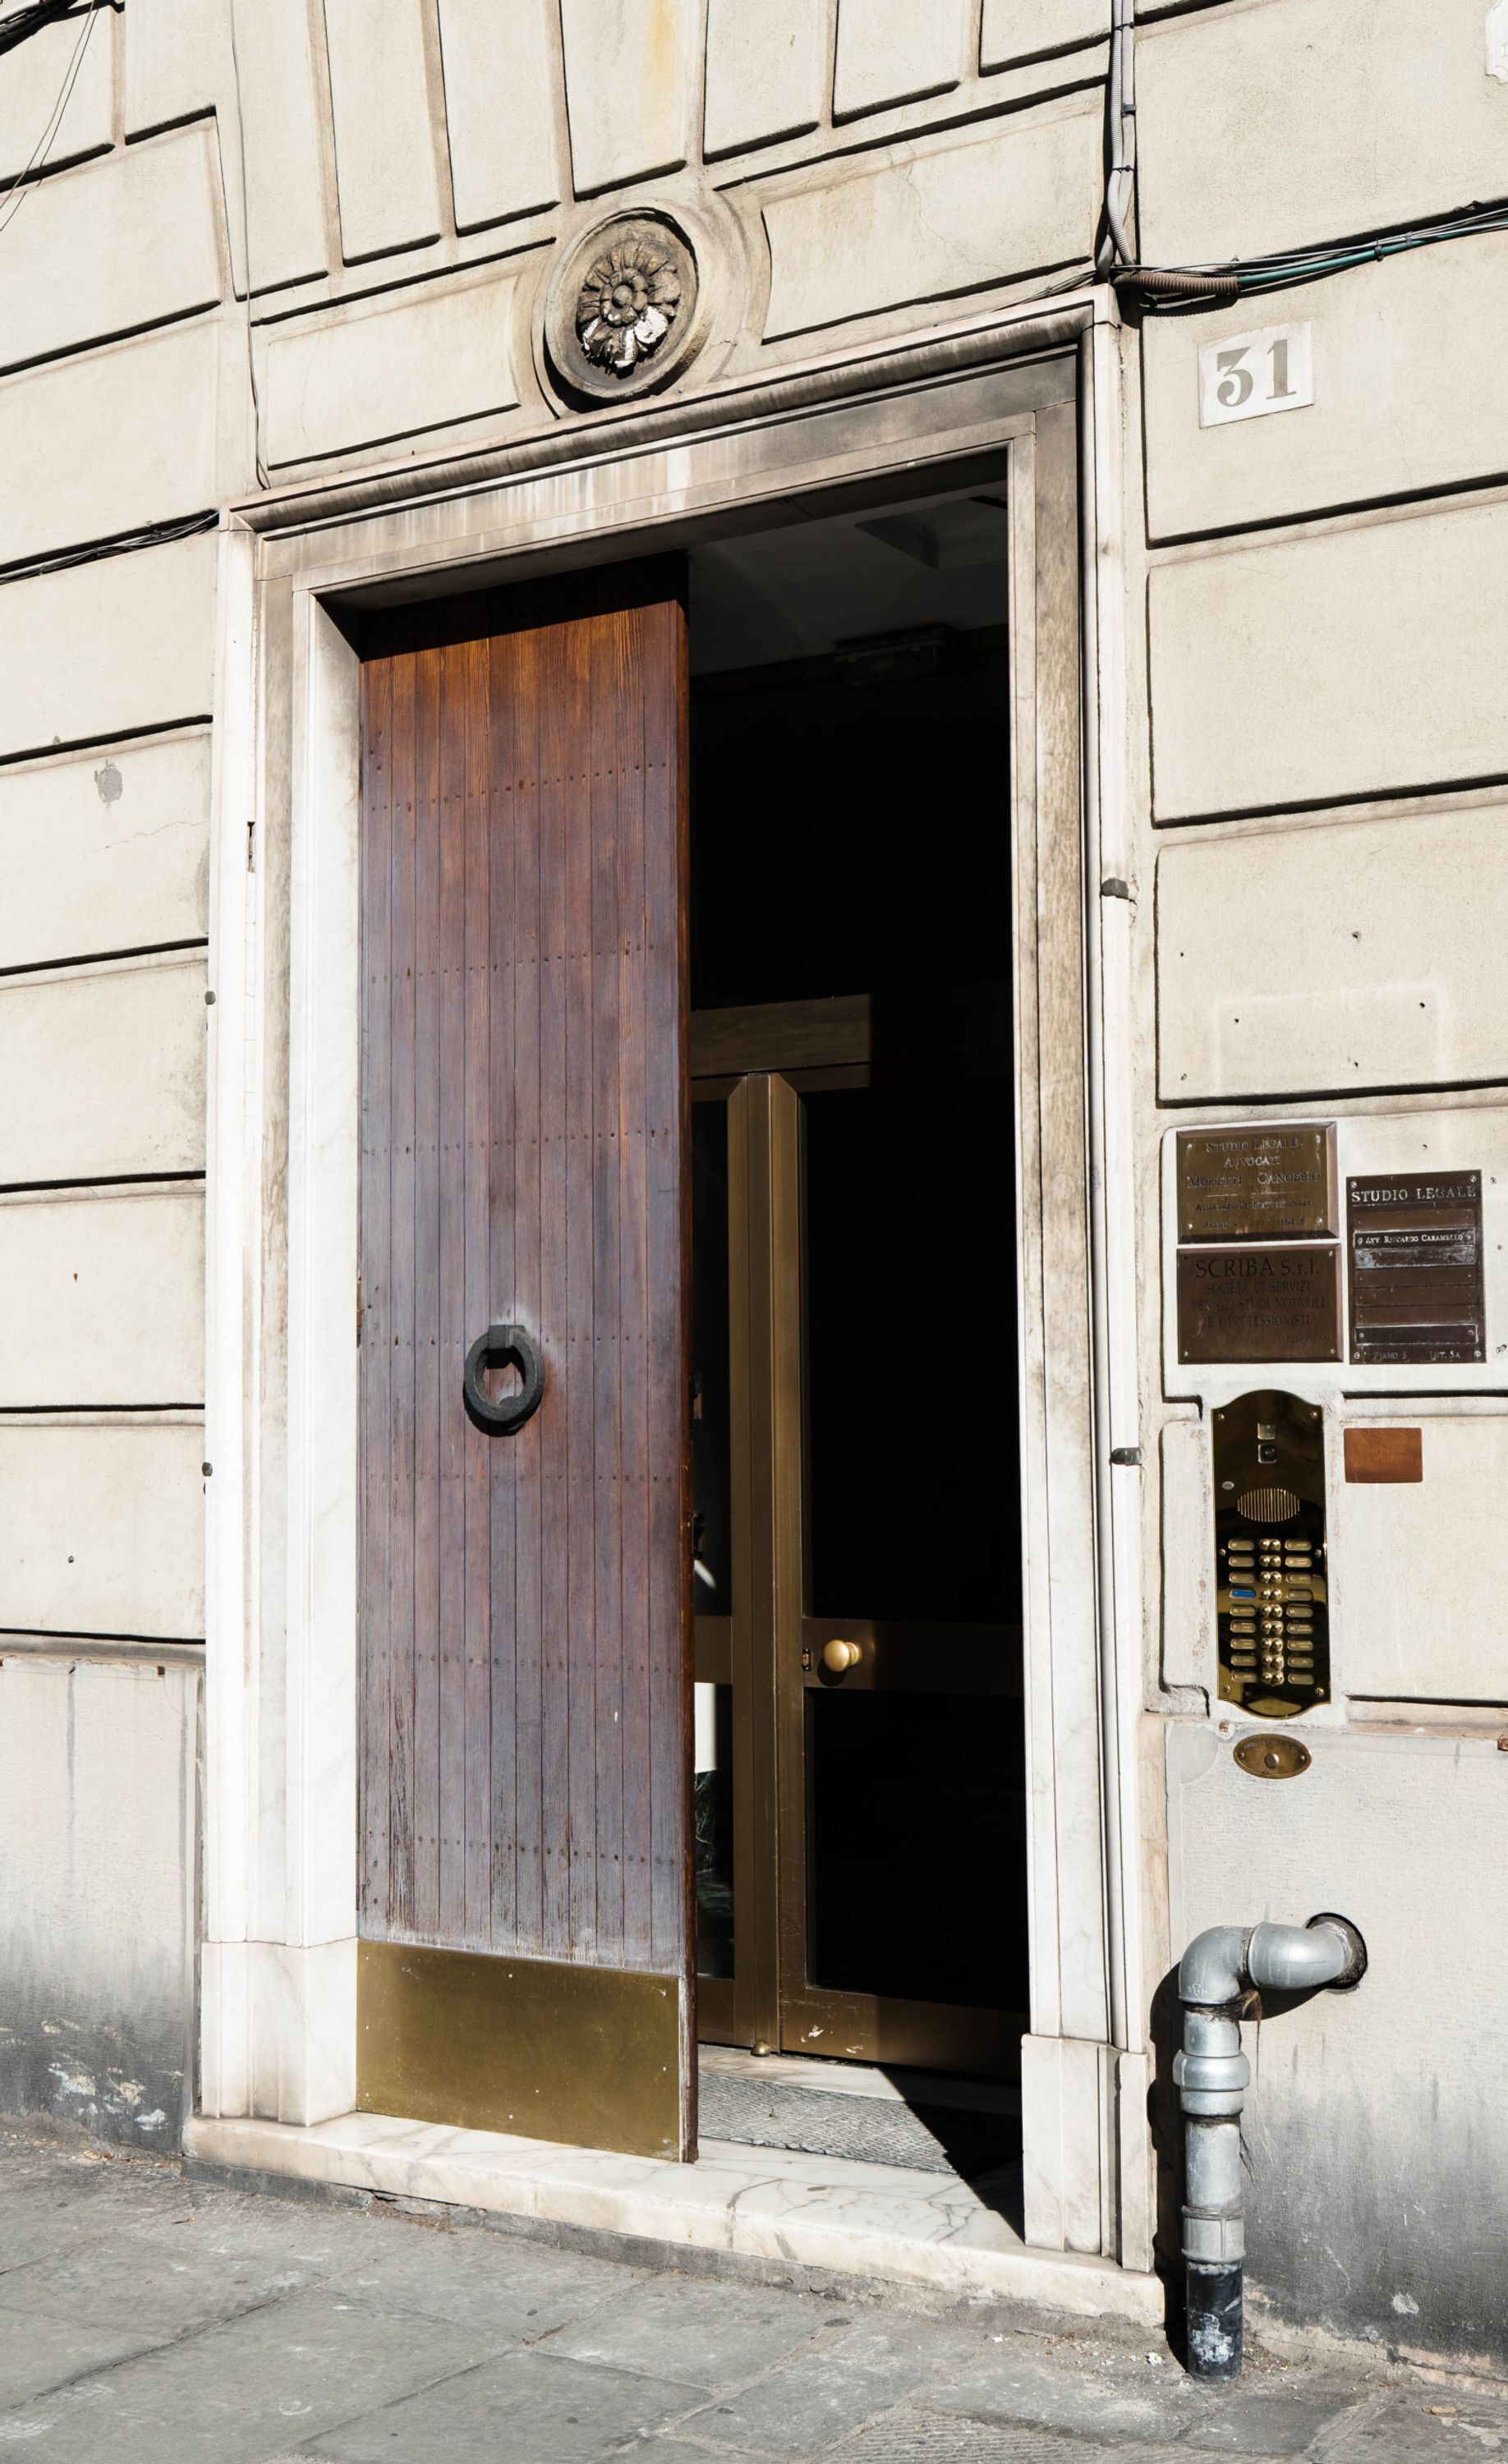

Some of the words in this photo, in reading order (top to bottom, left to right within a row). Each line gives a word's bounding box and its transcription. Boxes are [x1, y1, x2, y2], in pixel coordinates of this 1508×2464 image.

[1217, 339, 1296, 407] 31
[1206, 1142, 1248, 1152] STUDIO
[1351, 1188, 1408, 1202] STUDIO
[1416, 1186, 1477, 1200] LEGALE
[1195, 1257, 1274, 1278] SCRIBA
[1280, 1257, 1320, 1276] S.r.l.
[1271, 1280, 1310, 1292] SERVIZI
